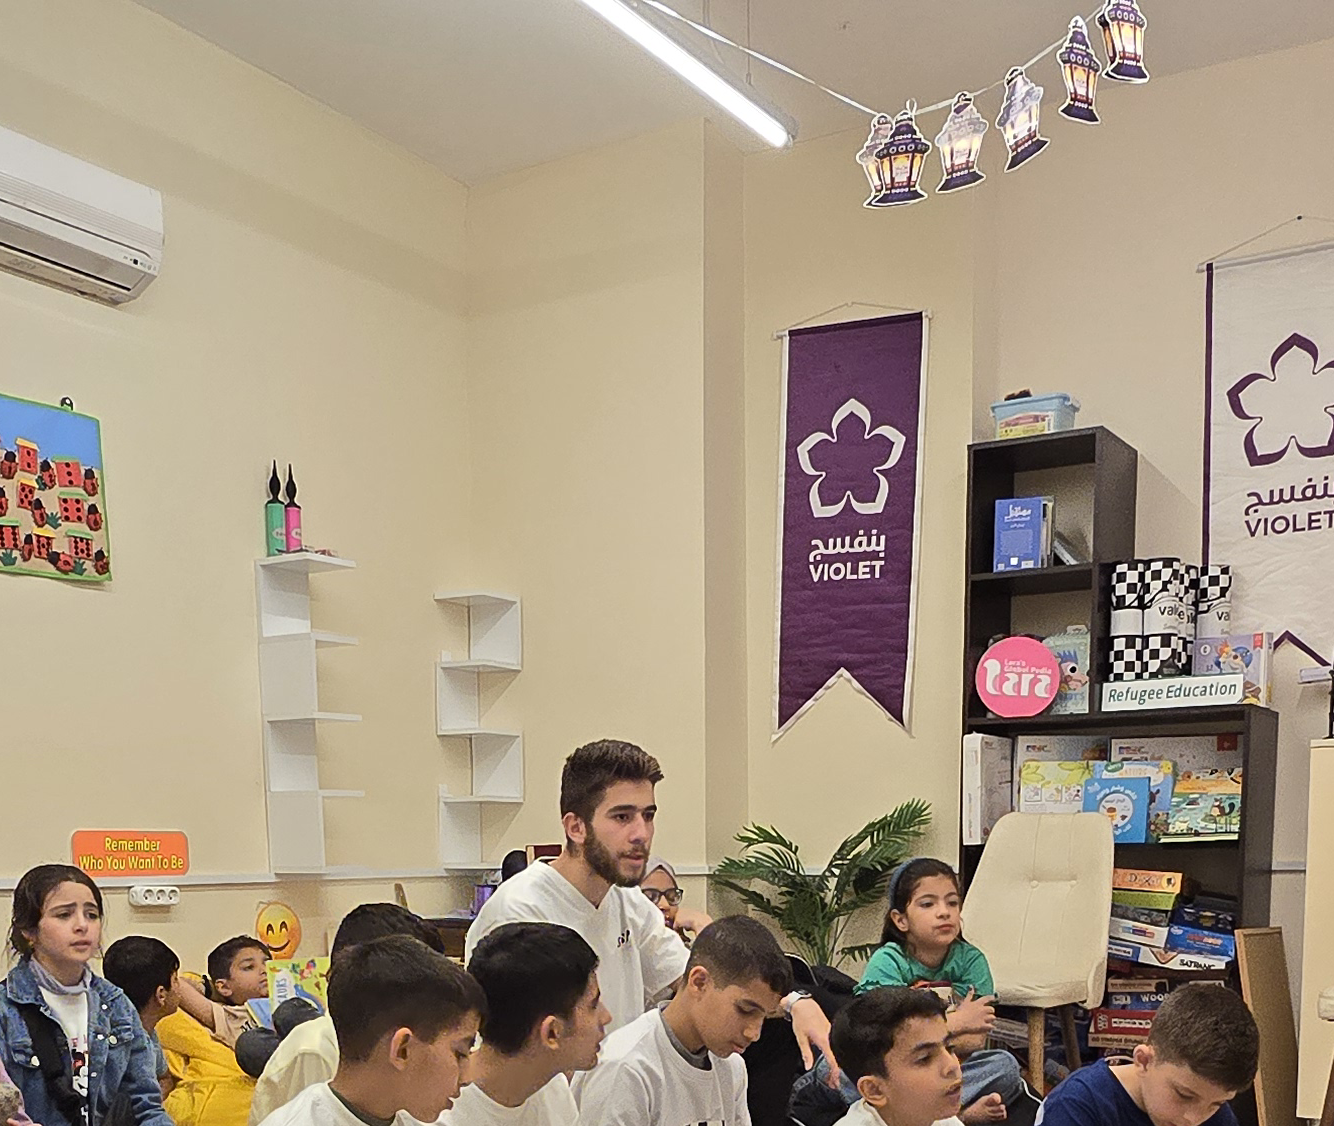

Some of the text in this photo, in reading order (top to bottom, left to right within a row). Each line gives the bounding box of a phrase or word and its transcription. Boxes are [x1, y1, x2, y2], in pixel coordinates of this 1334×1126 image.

[809, 529, 886, 563] بنفسج
[809, 561, 885, 582] VIOLET
[1108, 682, 1237, 705] Refugee Education
[105, 836, 161, 852] Remember
[79, 854, 184, 870] Who You Want To Be
